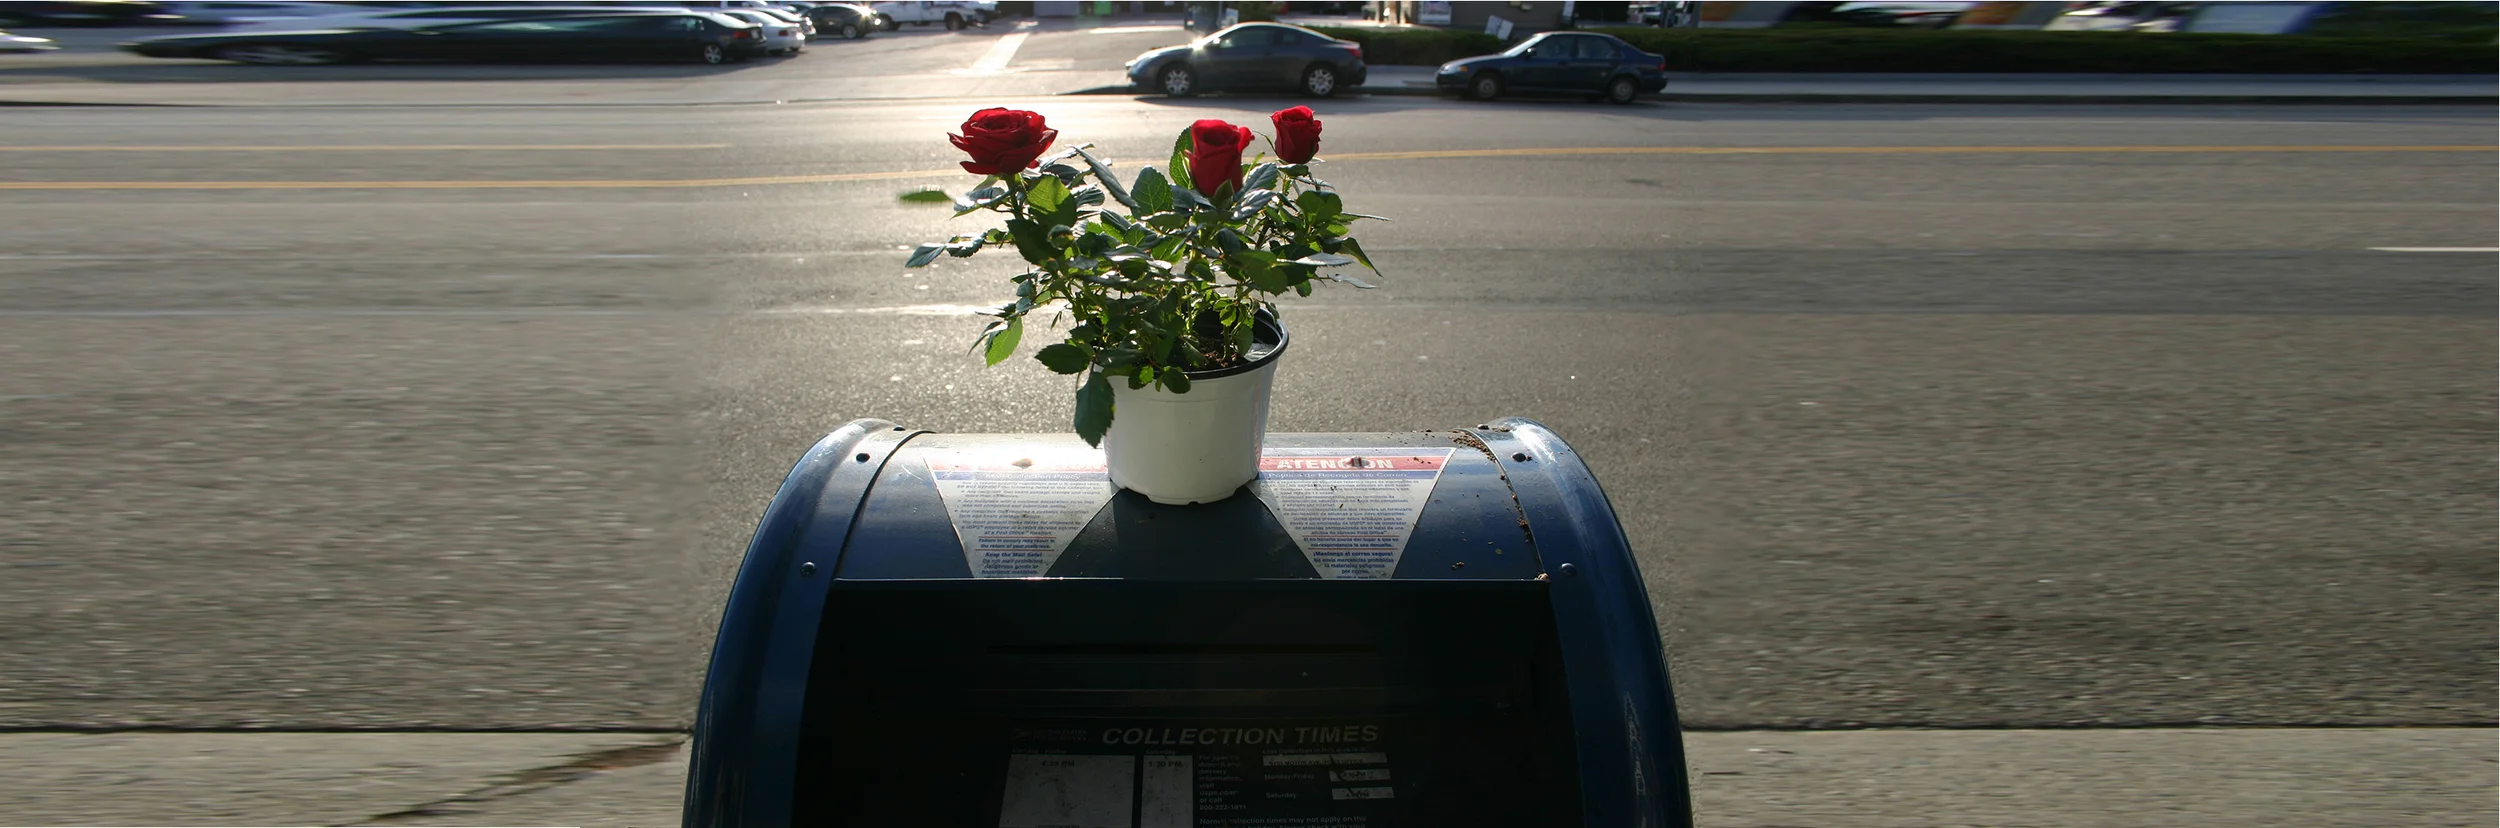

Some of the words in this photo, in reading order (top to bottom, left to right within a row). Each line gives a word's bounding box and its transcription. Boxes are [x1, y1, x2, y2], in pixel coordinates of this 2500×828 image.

[1277, 459, 1394, 469] ATENCN
[1102, 727, 1284, 745] COLLECTION
[1294, 724, 1379, 744] TIMES
[1147, 760, 1166, 768] 1:30
[1168, 760, 1182, 768] PM
[1265, 792, 1298, 801] Saturday
[1228, 817, 1265, 825] collection
[1320, 817, 1341, 825] apply
